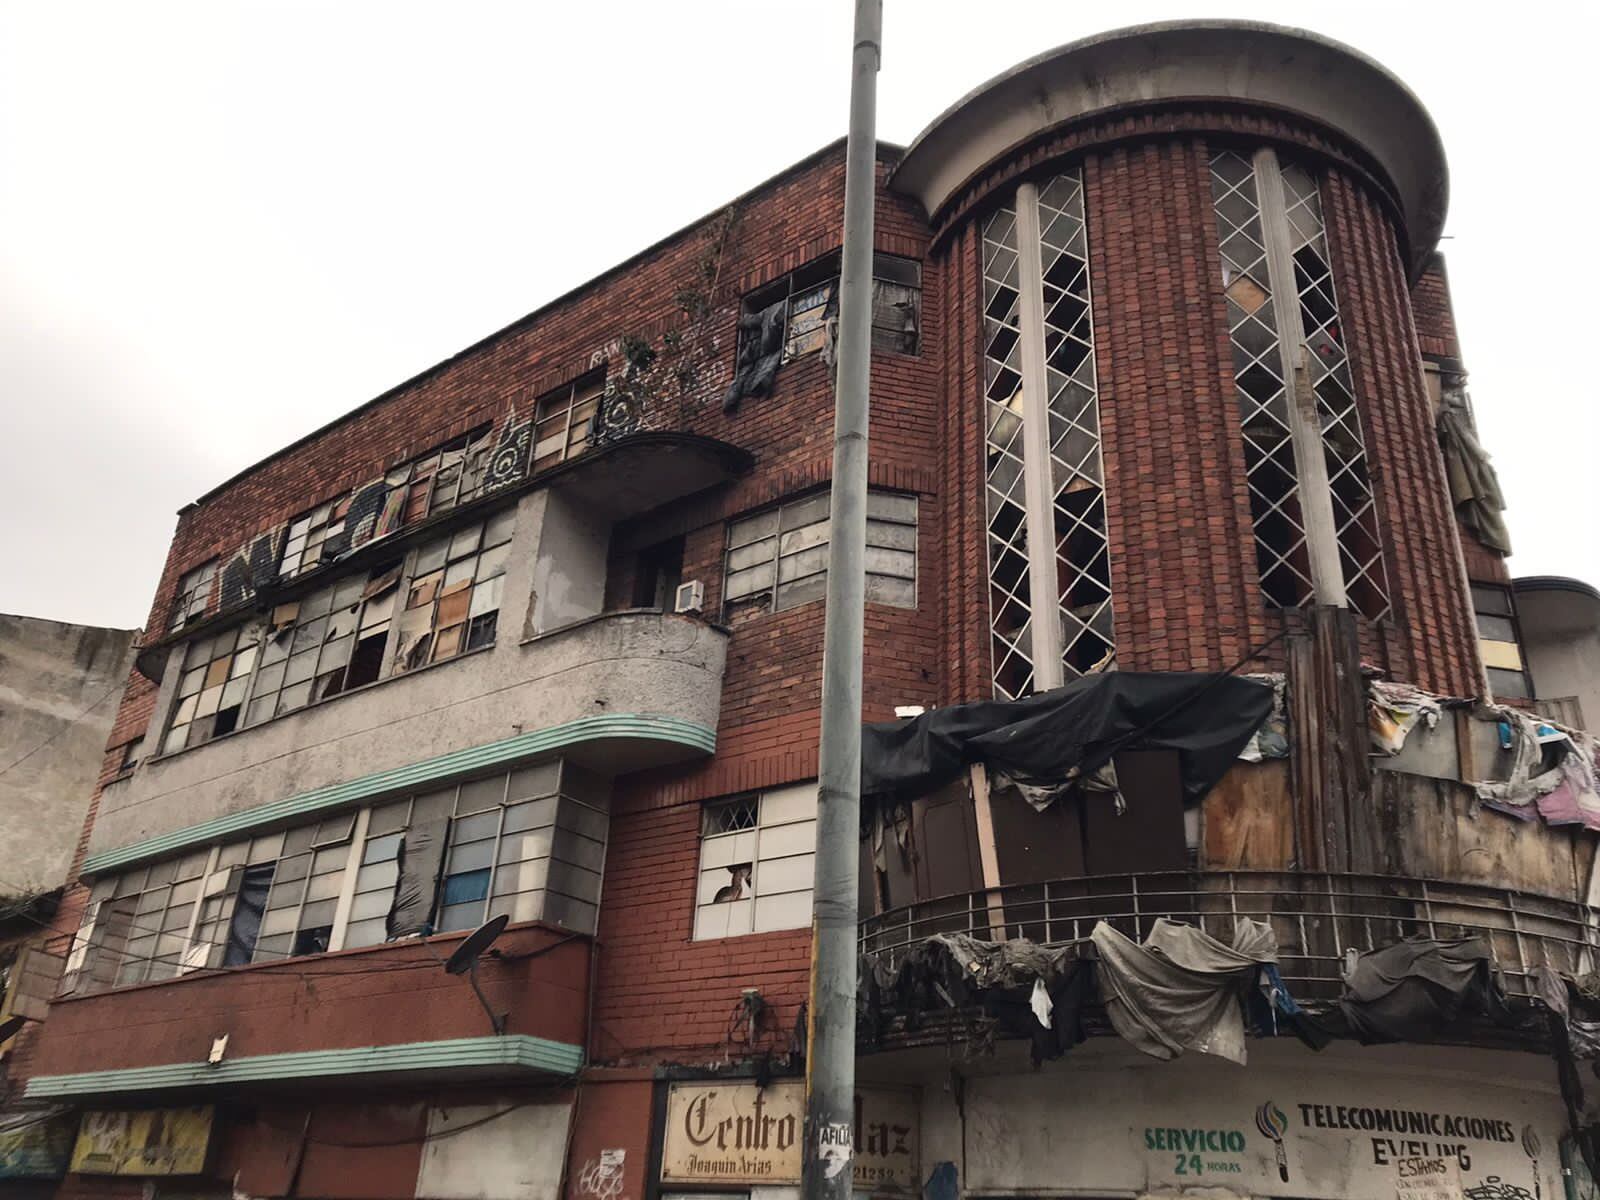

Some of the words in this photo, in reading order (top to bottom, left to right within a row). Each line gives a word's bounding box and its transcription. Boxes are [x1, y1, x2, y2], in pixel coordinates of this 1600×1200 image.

[684, 1089, 796, 1153] Centro
[1297, 1102, 1516, 1143] TELECOMUNICACIONES
[1144, 1127, 1247, 1153] SERVICIO
[1174, 1153, 1204, 1177] 24
[1206, 1161, 1243, 1174] HORAS
[1398, 1157, 1447, 1178] ESTAMOS
